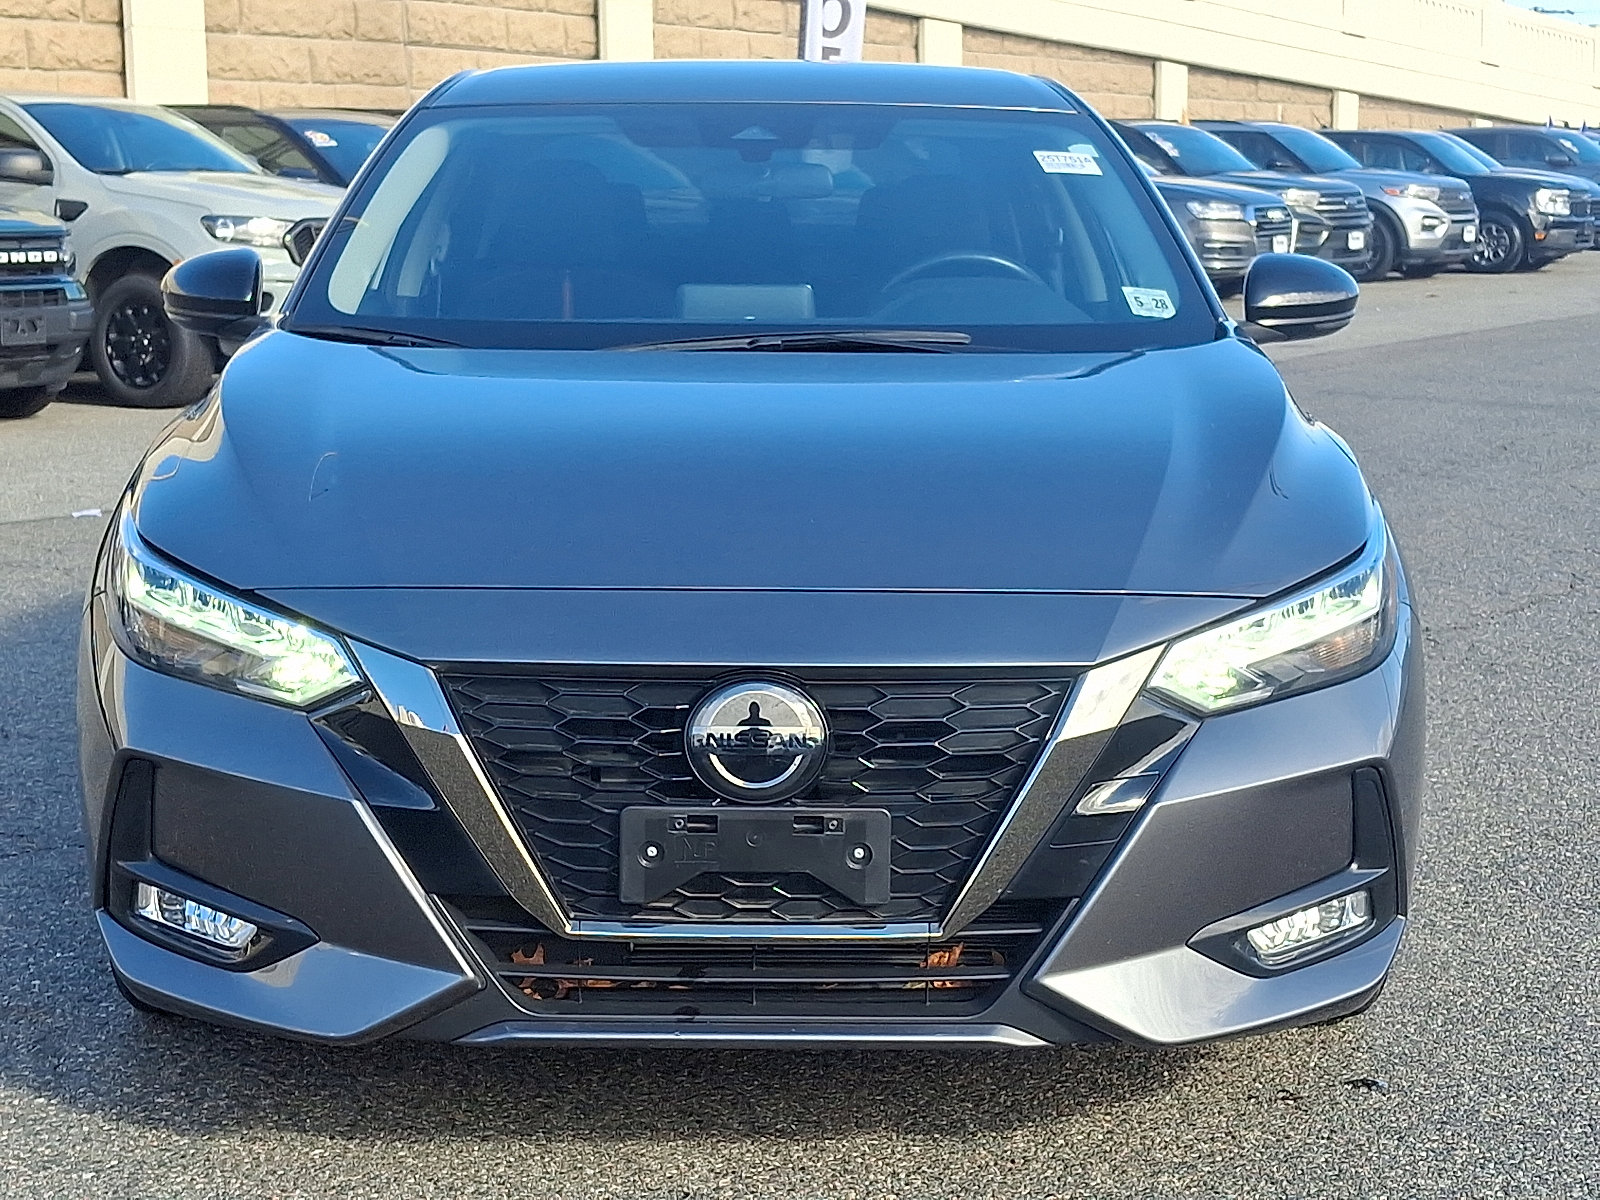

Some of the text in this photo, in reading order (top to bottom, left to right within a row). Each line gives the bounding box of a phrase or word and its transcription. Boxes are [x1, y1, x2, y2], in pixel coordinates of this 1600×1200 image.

[1133, 296, 1169, 309] 5 28
[705, 732, 807, 749] NISSAN
